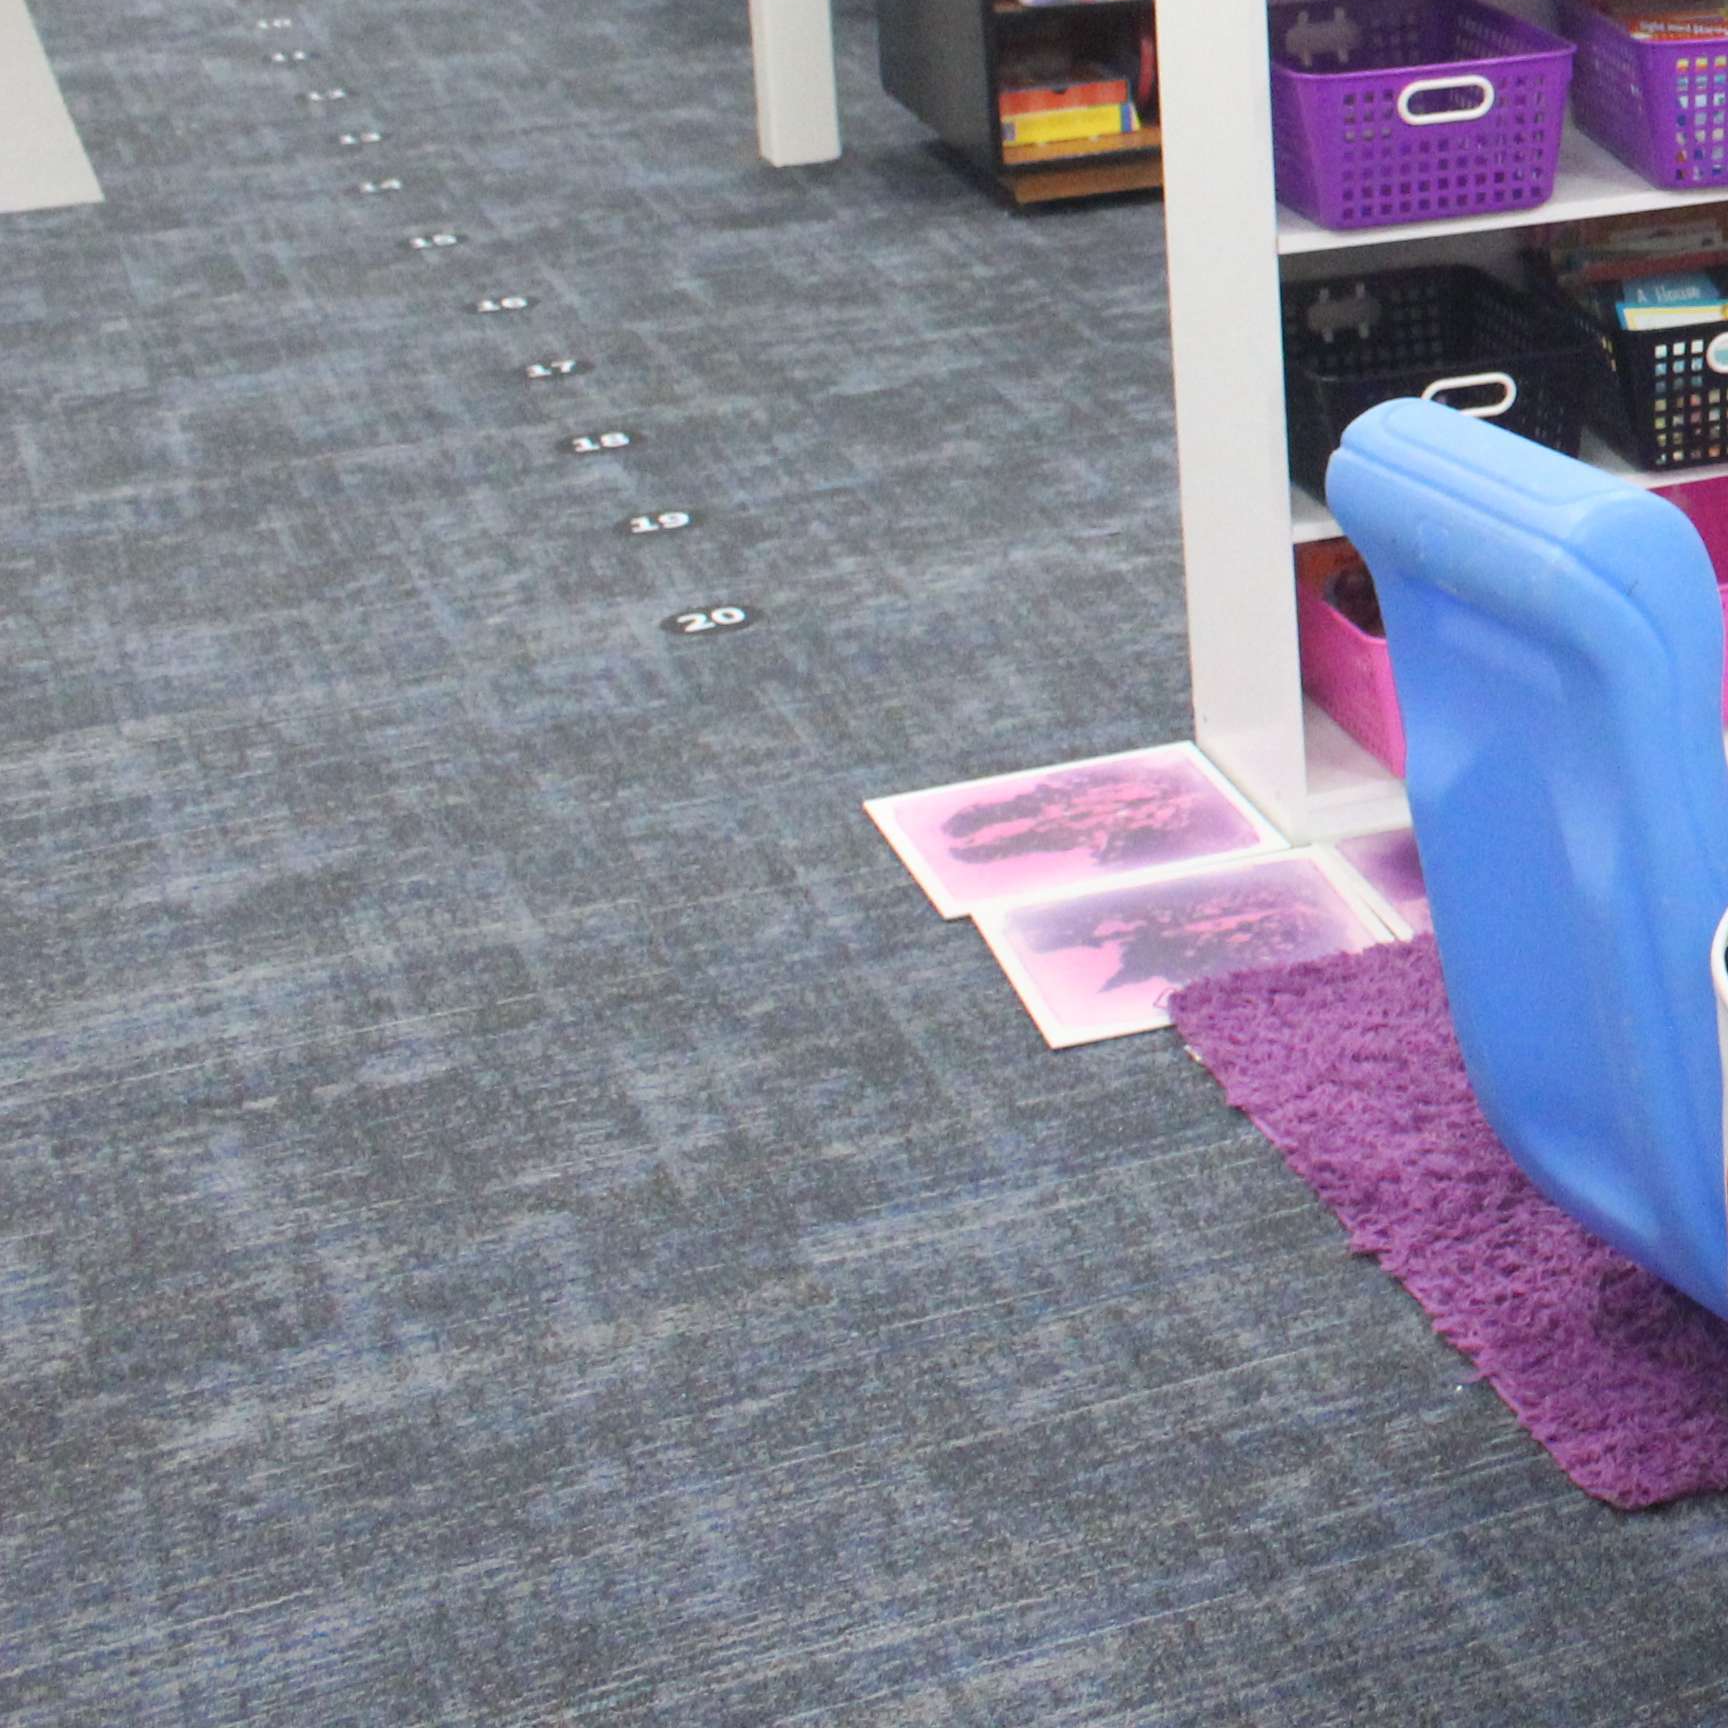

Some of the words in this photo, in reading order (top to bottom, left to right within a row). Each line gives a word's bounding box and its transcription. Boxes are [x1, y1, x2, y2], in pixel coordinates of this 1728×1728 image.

[477, 296, 528, 313] 16
[526, 358, 577, 379] 17
[572, 431, 630, 453] 18
[629, 511, 690, 534] 19
[676, 606, 746, 633] 20
